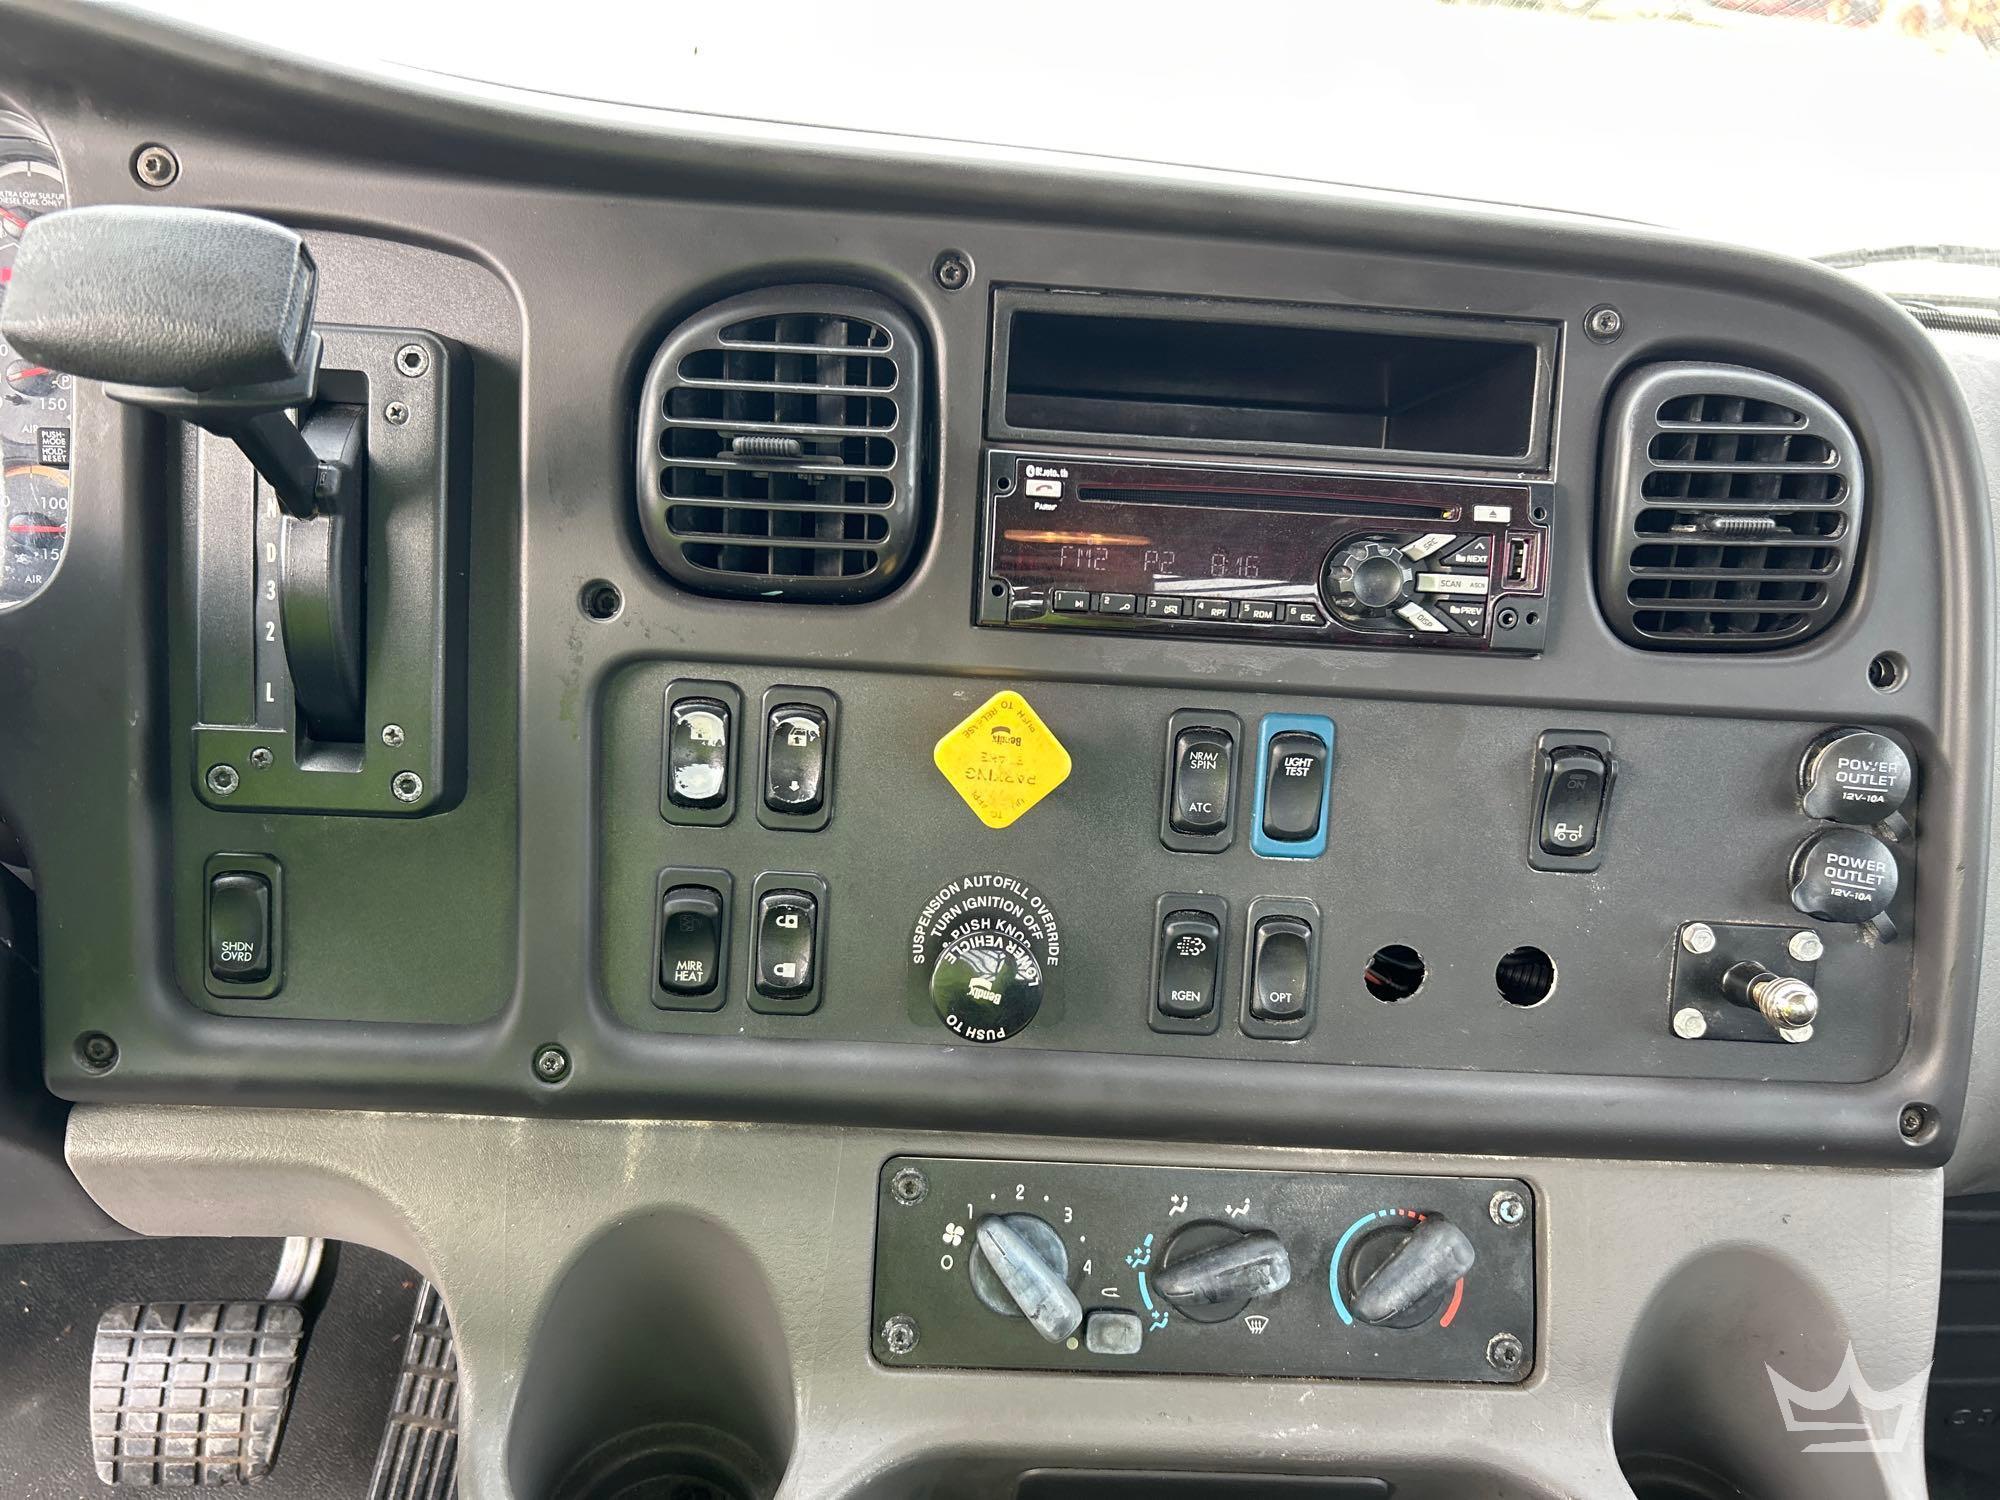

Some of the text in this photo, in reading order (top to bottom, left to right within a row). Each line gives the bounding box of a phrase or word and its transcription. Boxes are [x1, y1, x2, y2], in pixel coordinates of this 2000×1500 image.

[22, 198, 40, 206] FUEL
[41, 199, 62, 207] ONLY
[40, 398, 67, 410] 150
[40, 496, 68, 510] 100
[1424, 538, 1438, 551] SRC
[42, 548, 61, 560] 15
[266, 543, 276, 562] D
[1466, 555, 1488, 563] NEXT
[1060, 546, 1108, 571] FM2
[1210, 553, 1259, 578] 8:16
[25, 575, 42, 584] AIR
[1440, 580, 1462, 588] SCAN
[267, 580, 276, 600] 3
[1211, 608, 1227, 617] RPT
[1244, 604, 1272, 619] 5 RDM
[1461, 606, 1483, 615] PREV
[1300, 614, 1316, 622] ESC
[1417, 614, 1433, 627] DISP
[266, 621, 275, 641] 2
[266, 682, 274, 702] L
[1000, 701, 1014, 709] TO
[1189, 752, 1218, 761] NRM/
[1285, 757, 1313, 767] LIGHT
[1190, 760, 1217, 770] SPIN
[1838, 758, 1898, 773] POWER
[1285, 767, 1310, 777] TEST
[1567, 780, 1586, 789] ON
[1835, 772, 1897, 787] OUTLET
[1842, 792, 1884, 803] 12V-10A
[1189, 802, 1212, 813] ATC
[1826, 853, 1887, 873] POWER
[1824, 867, 1885, 886] OUTLET
[1831, 888, 1872, 902] 12V-10A
[913, 875, 1059, 966] SUSPENSION AUTOFILL OVERRIDE
[930, 896, 1044, 941] TURN IGNITION OFF
[950, 918, 990, 940] PUSH
[222, 941, 253, 952] SHDN
[221, 952, 252, 962] OVRD
[944, 935, 1039, 986] LOWER VEHICLE
[676, 960, 702, 971] MIRR
[675, 971, 703, 982] HEAT
[967, 988, 1002, 1004] Bendix
[1171, 990, 1200, 1002] RGEN
[1270, 992, 1292, 1003] OPT
[946, 1014, 1006, 1041] PUSH TO
[1016, 1184, 1024, 1200] 2
[967, 1204, 973, 1219] 1
[1064, 1207, 1072, 1223] 3
[1083, 1260, 1092, 1274] 4
